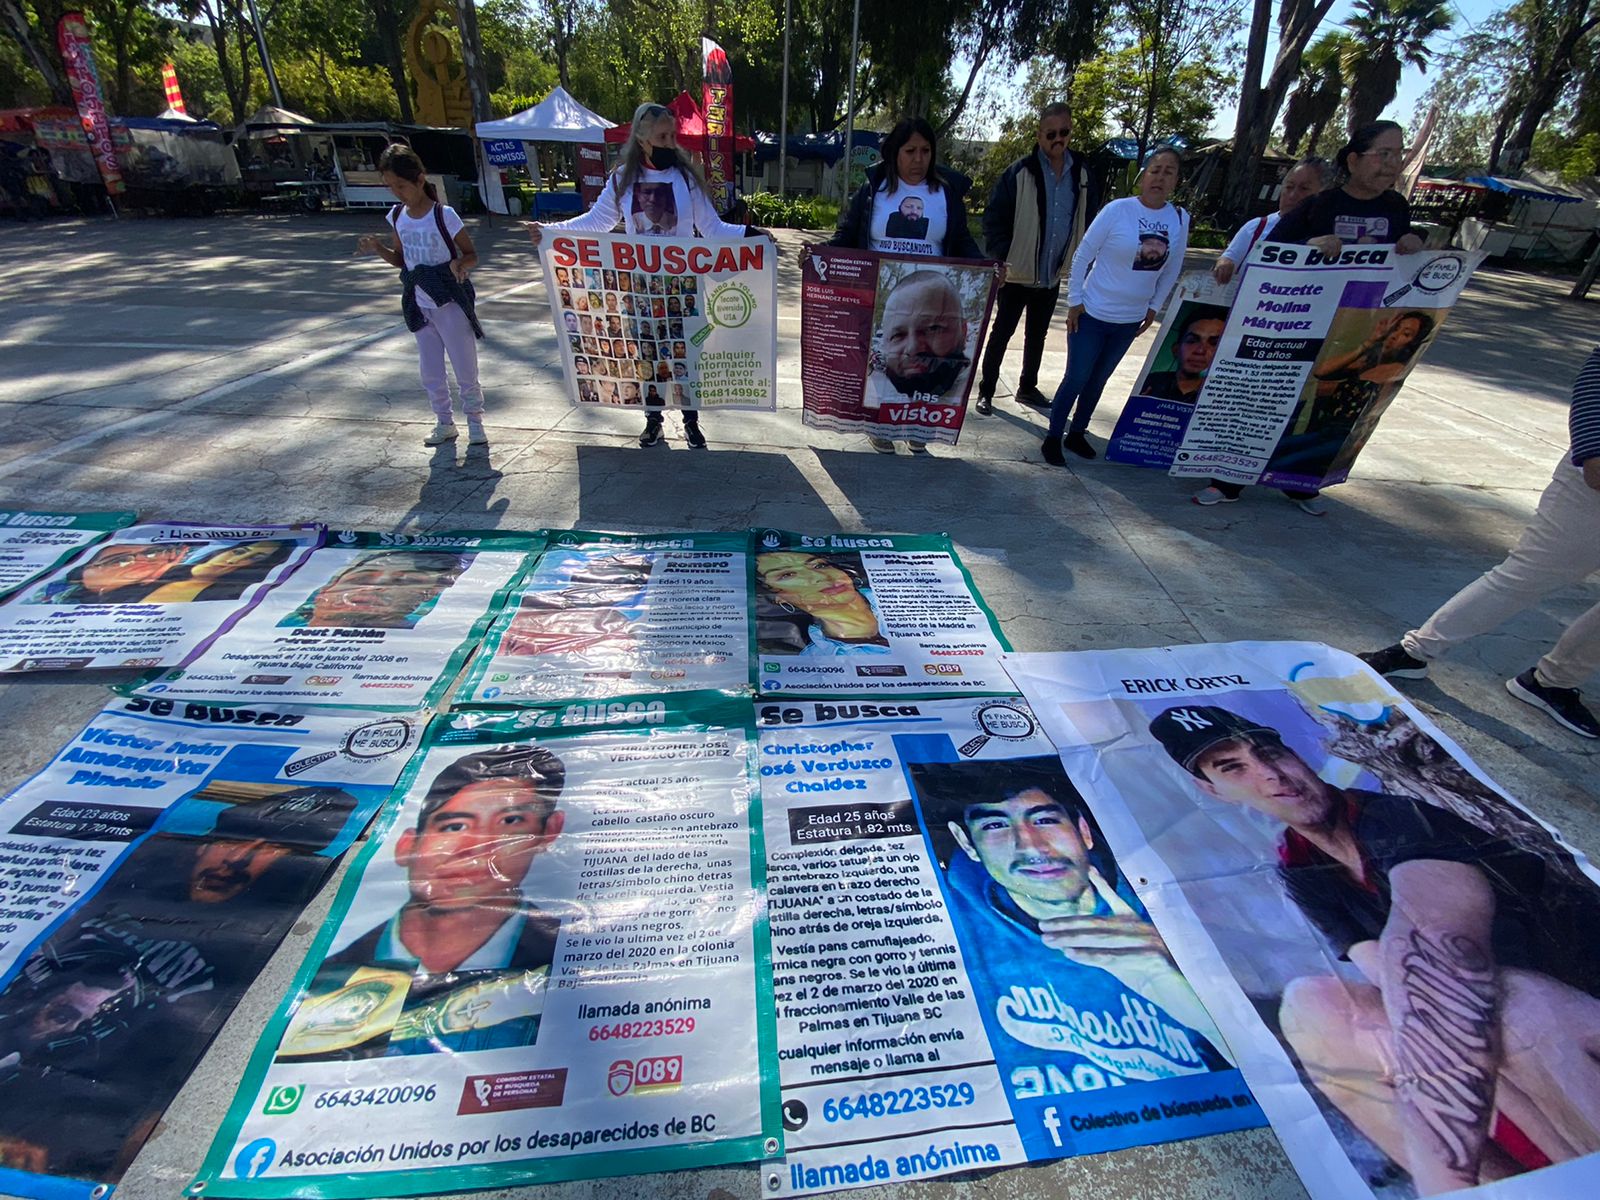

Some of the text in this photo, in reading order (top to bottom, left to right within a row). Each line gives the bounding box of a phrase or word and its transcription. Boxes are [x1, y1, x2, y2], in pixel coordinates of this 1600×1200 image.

[490, 141, 515, 151] ACTAS
[488, 151, 526, 163] PERMISOS
[552, 237, 764, 274] SE BUSCAN
[1260, 246, 1389, 266] Se busca
[1259, 282, 1323, 296] Suzette
[1256, 300, 1311, 313] Molina
[1242, 316, 1312, 332] Márquez
[1246, 338, 1306, 349] Edad actual
[701, 350, 755, 361] Cualquier
[1253, 351, 1292, 359] 18 años
[694, 359, 761, 370] información
[690, 378, 770, 388] comunicate al:
[704, 369, 754, 381] por favor
[695, 388, 767, 398] 6648149962
[913, 390, 939, 402] has
[889, 404, 956, 424] visto?
[1193, 454, 1258, 468] 6648223529
[1214, 468, 1254, 480] anónima
[7, 512, 77, 526] busca
[801, 535, 894, 548] Se busca
[222, 652, 282, 661] Desapareció
[290, 662, 312, 670] Baja
[315, 663, 363, 671] California
[787, 666, 845, 674] 6643420096
[938, 664, 960, 673] 089
[352, 673, 389, 681] llamada
[1120, 674, 1251, 694] ERICK ORTIZ
[784, 681, 880, 690] Asociación Unidos por
[124, 698, 305, 727] Se busca
[514, 700, 666, 729] Se busca
[760, 702, 921, 726] Se busca
[164, 741, 229, 756] Iván
[369, 739, 400, 747] BUSCA
[762, 740, 874, 758] Christopher
[61, 747, 210, 775] Amezquita
[289, 752, 335, 772] COLECTIVO
[800, 758, 892, 774] Verduzco
[784, 777, 868, 794] Chaidez
[50, 807, 130, 821] Edad 23 años
[591, 811, 715, 827] cabello castaño oscuro
[808, 809, 896, 826] Edad 25 años
[25, 817, 133, 835] Estatura 1.70 mts
[796, 822, 912, 841] Estatura 1.82 mts
[583, 855, 628, 868] TIJUANA
[563, 947, 674, 963] marzo del 2020 en
[577, 996, 711, 1020] llamada anónima
[784, 994, 924, 1019] fraccionamiento Valle
[799, 1007, 943, 1033] Palmas en Tijuana BC
[588, 1017, 696, 1042] 6648223529
[778, 1028, 964, 1061] cualquier información envía
[637, 1058, 681, 1083] 089
[811, 1049, 940, 1076] mensaje o llama al
[314, 1083, 438, 1110] 6643420096
[822, 1083, 976, 1123] 6648223529
[1070, 1109, 1139, 1131] Colectivo
[1141, 1105, 1158, 1121] de
[1165, 1095, 1232, 1117] búsqueda
[279, 1114, 716, 1168] Asociación Unidos por los desaparecidos de BC
[789, 1143, 1001, 1191] llamada anónima
